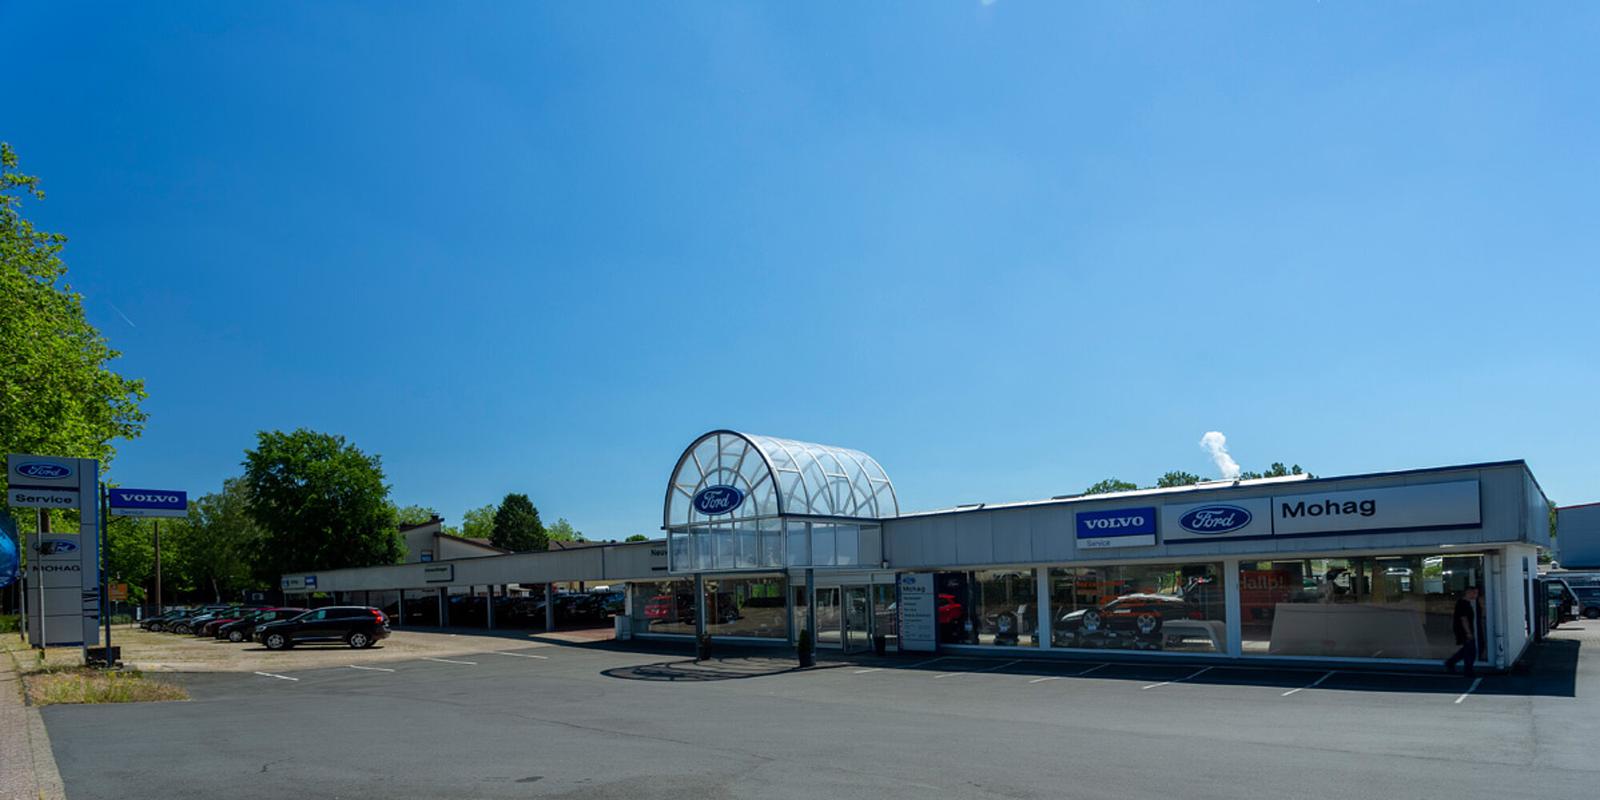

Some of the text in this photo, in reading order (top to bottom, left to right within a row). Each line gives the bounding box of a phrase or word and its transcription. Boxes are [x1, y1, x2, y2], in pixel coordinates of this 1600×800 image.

[27, 464, 61, 477] Ford
[15, 493, 73, 504] Service
[120, 494, 179, 503] VOLVO
[701, 491, 730, 509] Ford
[1281, 499, 1376, 519] Mohag
[1083, 516, 1144, 530] VOLVO
[1192, 510, 1236, 529] Ford
